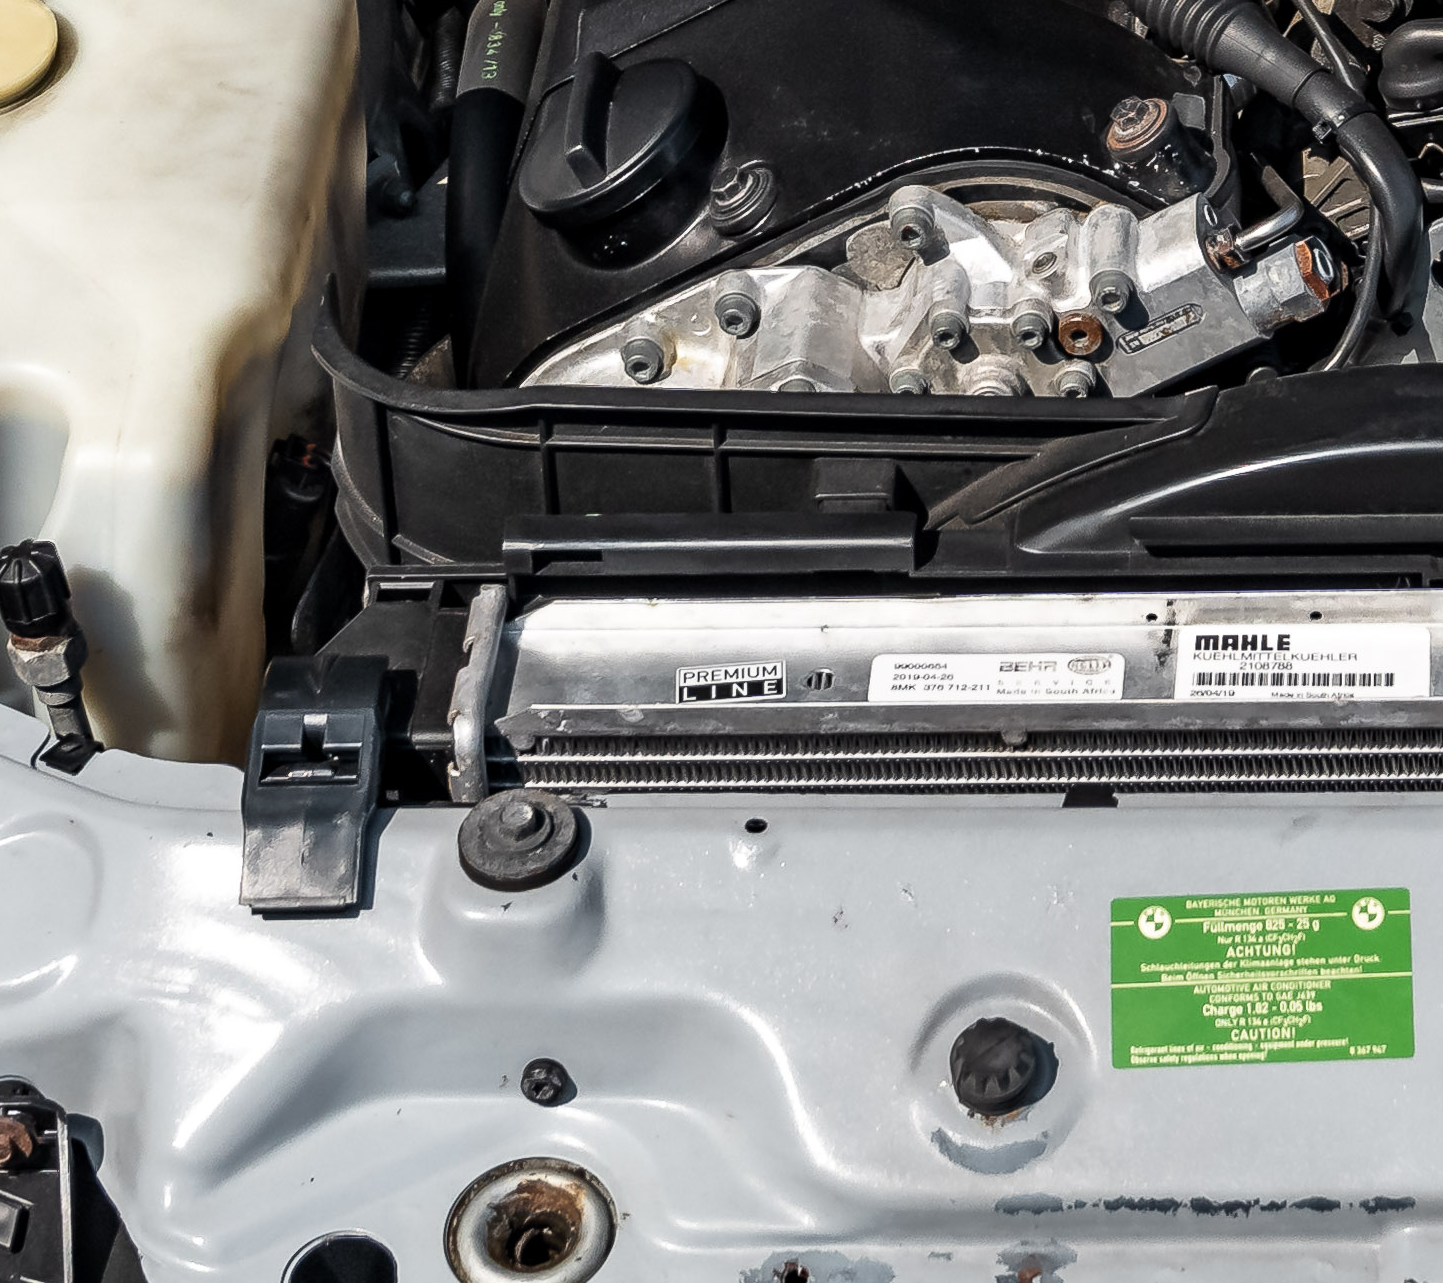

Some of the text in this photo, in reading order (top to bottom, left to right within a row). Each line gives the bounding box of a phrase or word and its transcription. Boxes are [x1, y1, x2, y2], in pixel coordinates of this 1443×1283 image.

[1195, 634, 1291, 651] MAHLE
[1193, 652, 1358, 662] KUEHLMITTELKUEHLER
[999, 661, 1057, 672] BEHR
[1240, 662, 1293, 670] 2108788
[683, 665, 777, 684] PREMIUM
[892, 673, 954, 681] 2019-04-26
[683, 680, 777, 701] LINE
[1186, 898, 1240, 909] BAYERISCHE
[1243, 896, 1287, 907] MOTOREN
[1289, 894, 1321, 904] WERKE
[1264, 905, 1308, 915] GERMANY
[1202, 920, 1263, 934] Füllmenge
[1312, 919, 1320, 932] g
[1226, 943, 1296, 958] ACHTUNG!
[1222, 960, 1237, 969] der
[1193, 980, 1331, 994] AUTOMOTIVE AIR CONDITIONER
[1209, 993, 1259, 1004] CONFORMS
[1262, 992, 1273, 1001] TO
[1202, 1003, 1243, 1018] Charge
[1305, 1000, 1323, 1012] lbs
[1215, 1018, 1237, 1028] ONLY
[1230, 1026, 1296, 1041] CAUTION!
